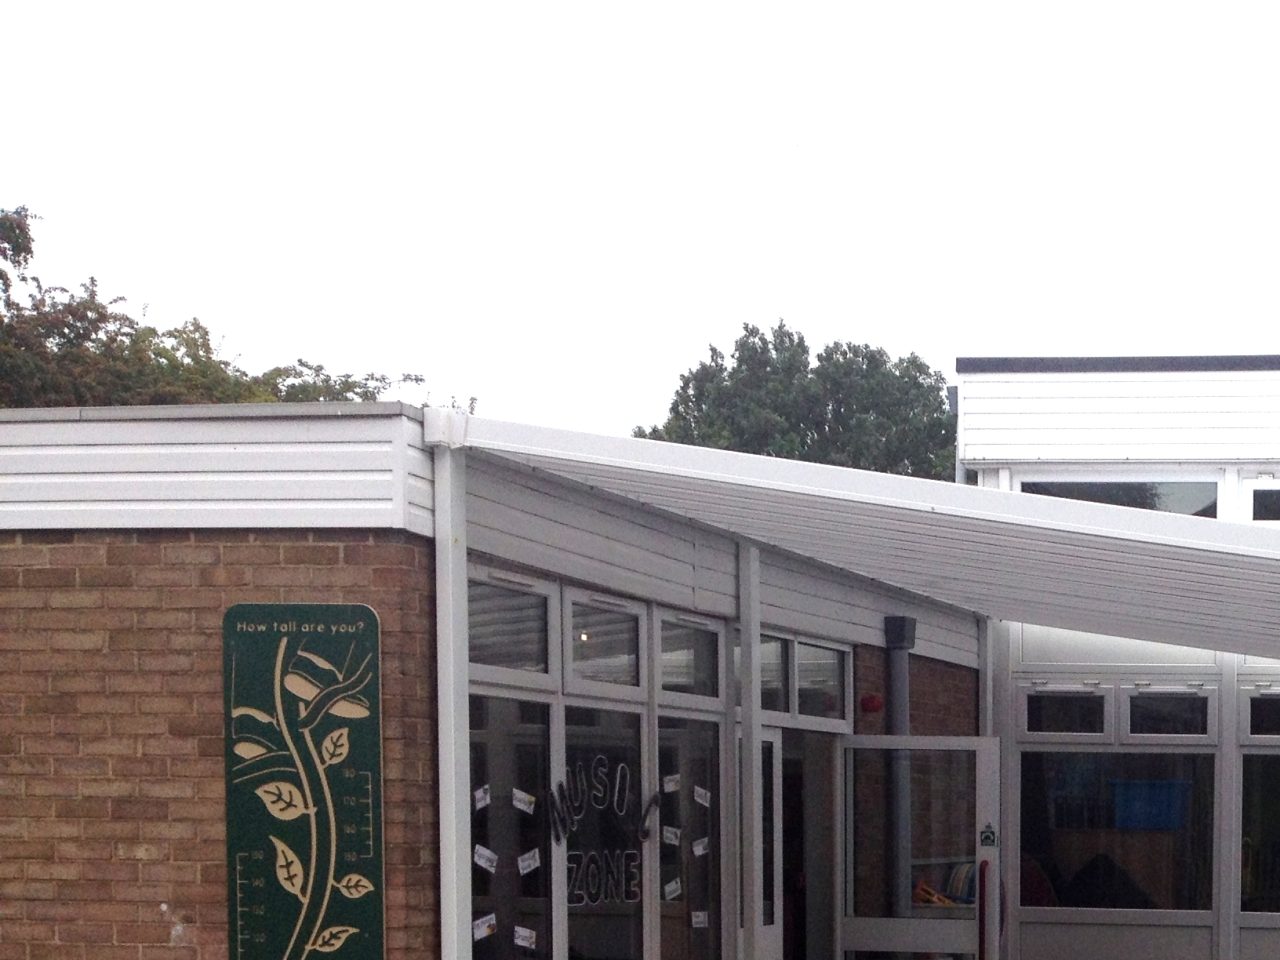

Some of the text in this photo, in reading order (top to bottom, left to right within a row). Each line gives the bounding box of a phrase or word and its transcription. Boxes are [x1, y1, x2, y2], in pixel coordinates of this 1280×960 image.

[236, 621, 365, 635] How tall are you?
[549, 754, 662, 847] MUSIC
[566, 850, 641, 906] ZONE
